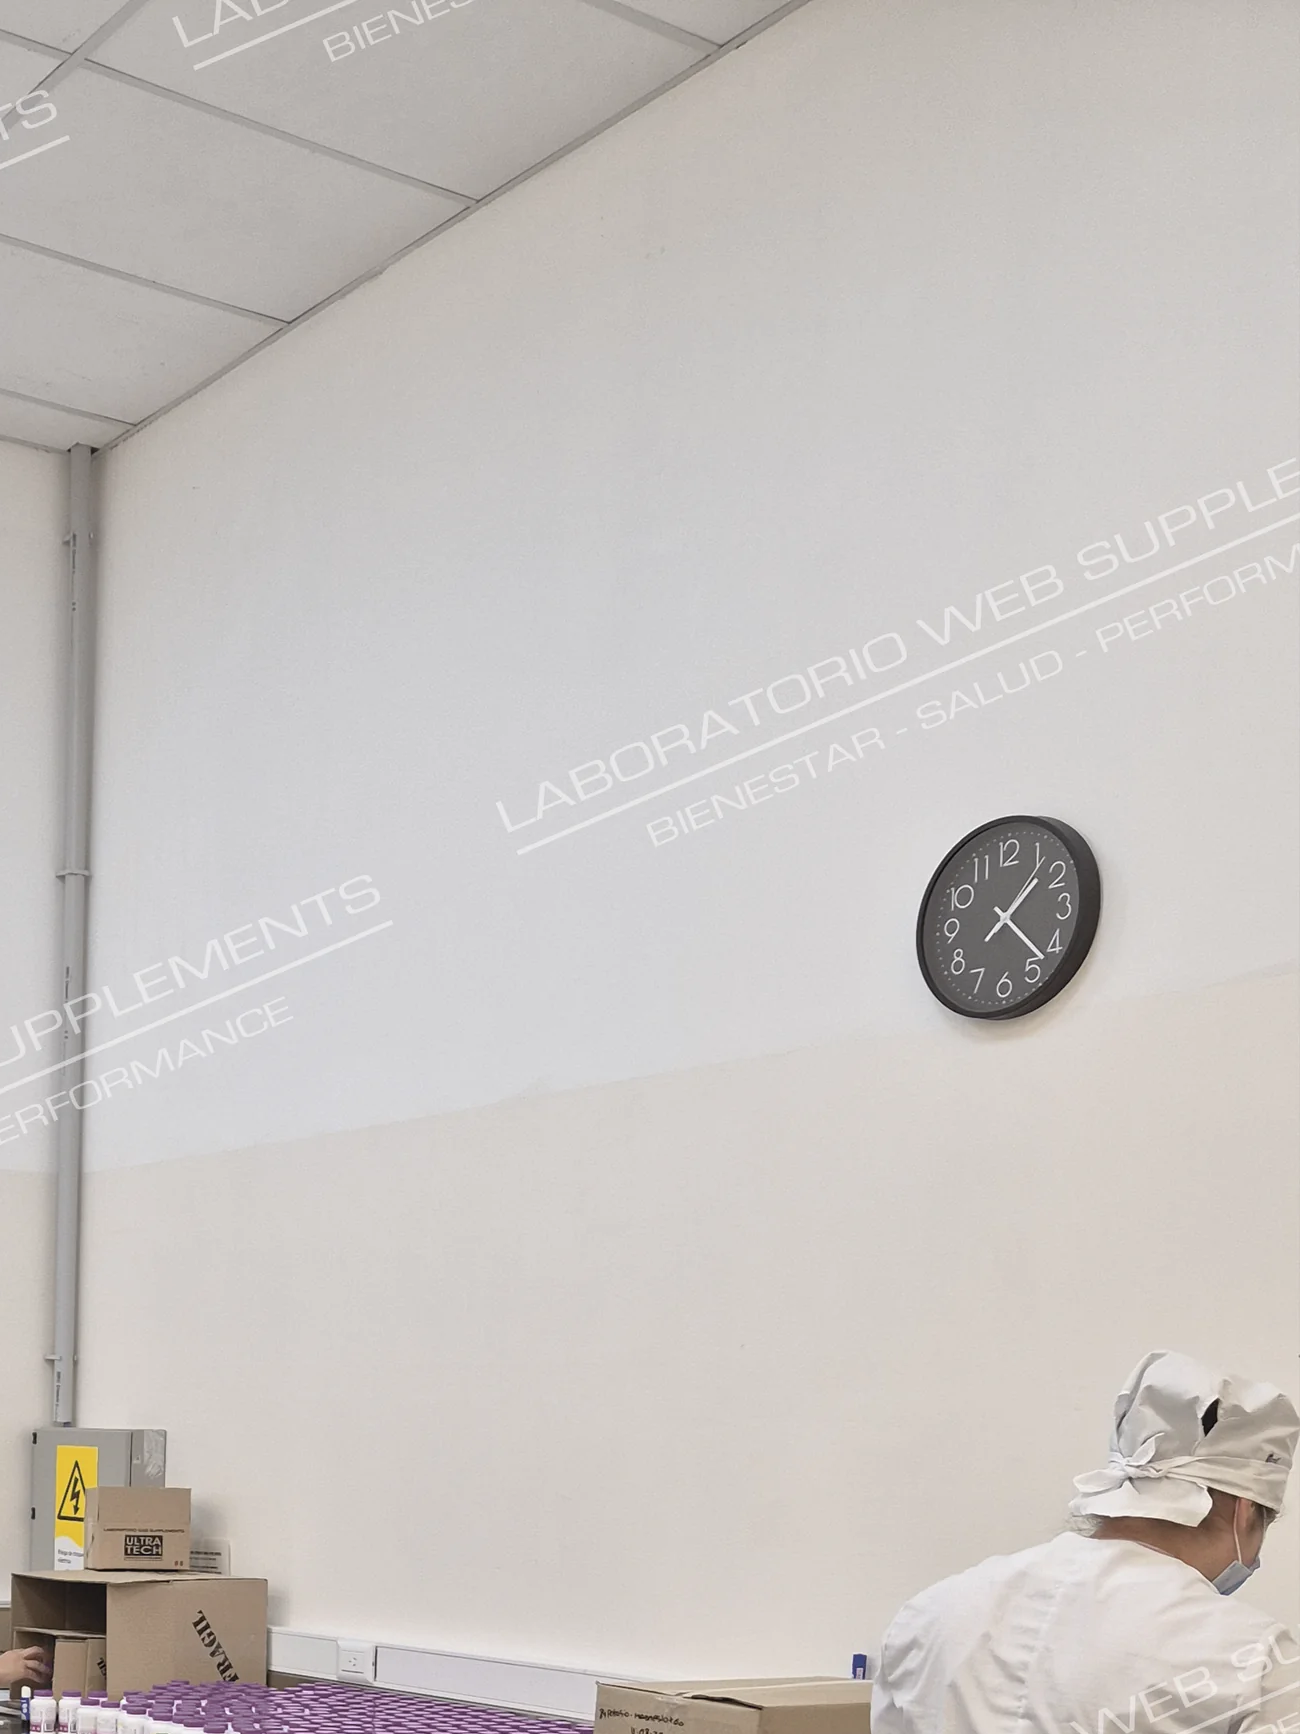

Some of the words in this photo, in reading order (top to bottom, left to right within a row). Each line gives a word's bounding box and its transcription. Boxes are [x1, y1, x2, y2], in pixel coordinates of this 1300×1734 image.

[999, 839, 1019, 867] 12
[1035, 842, 1040, 867] 1
[974, 855, 989, 883] 11
[1048, 861, 1066, 889] 2
[951, 884, 974, 911] 10
[1056, 893, 1071, 919] 3
[944, 918, 960, 944] 9
[1046, 928, 1062, 953] 4
[951, 948, 965, 974] 8
[1025, 956, 1041, 983] 5
[970, 968, 985, 993] 7
[996, 971, 1012, 997] 6
[125, 1546, 162, 1555] TECH
[126, 1536, 161, 1546] ULTRA
